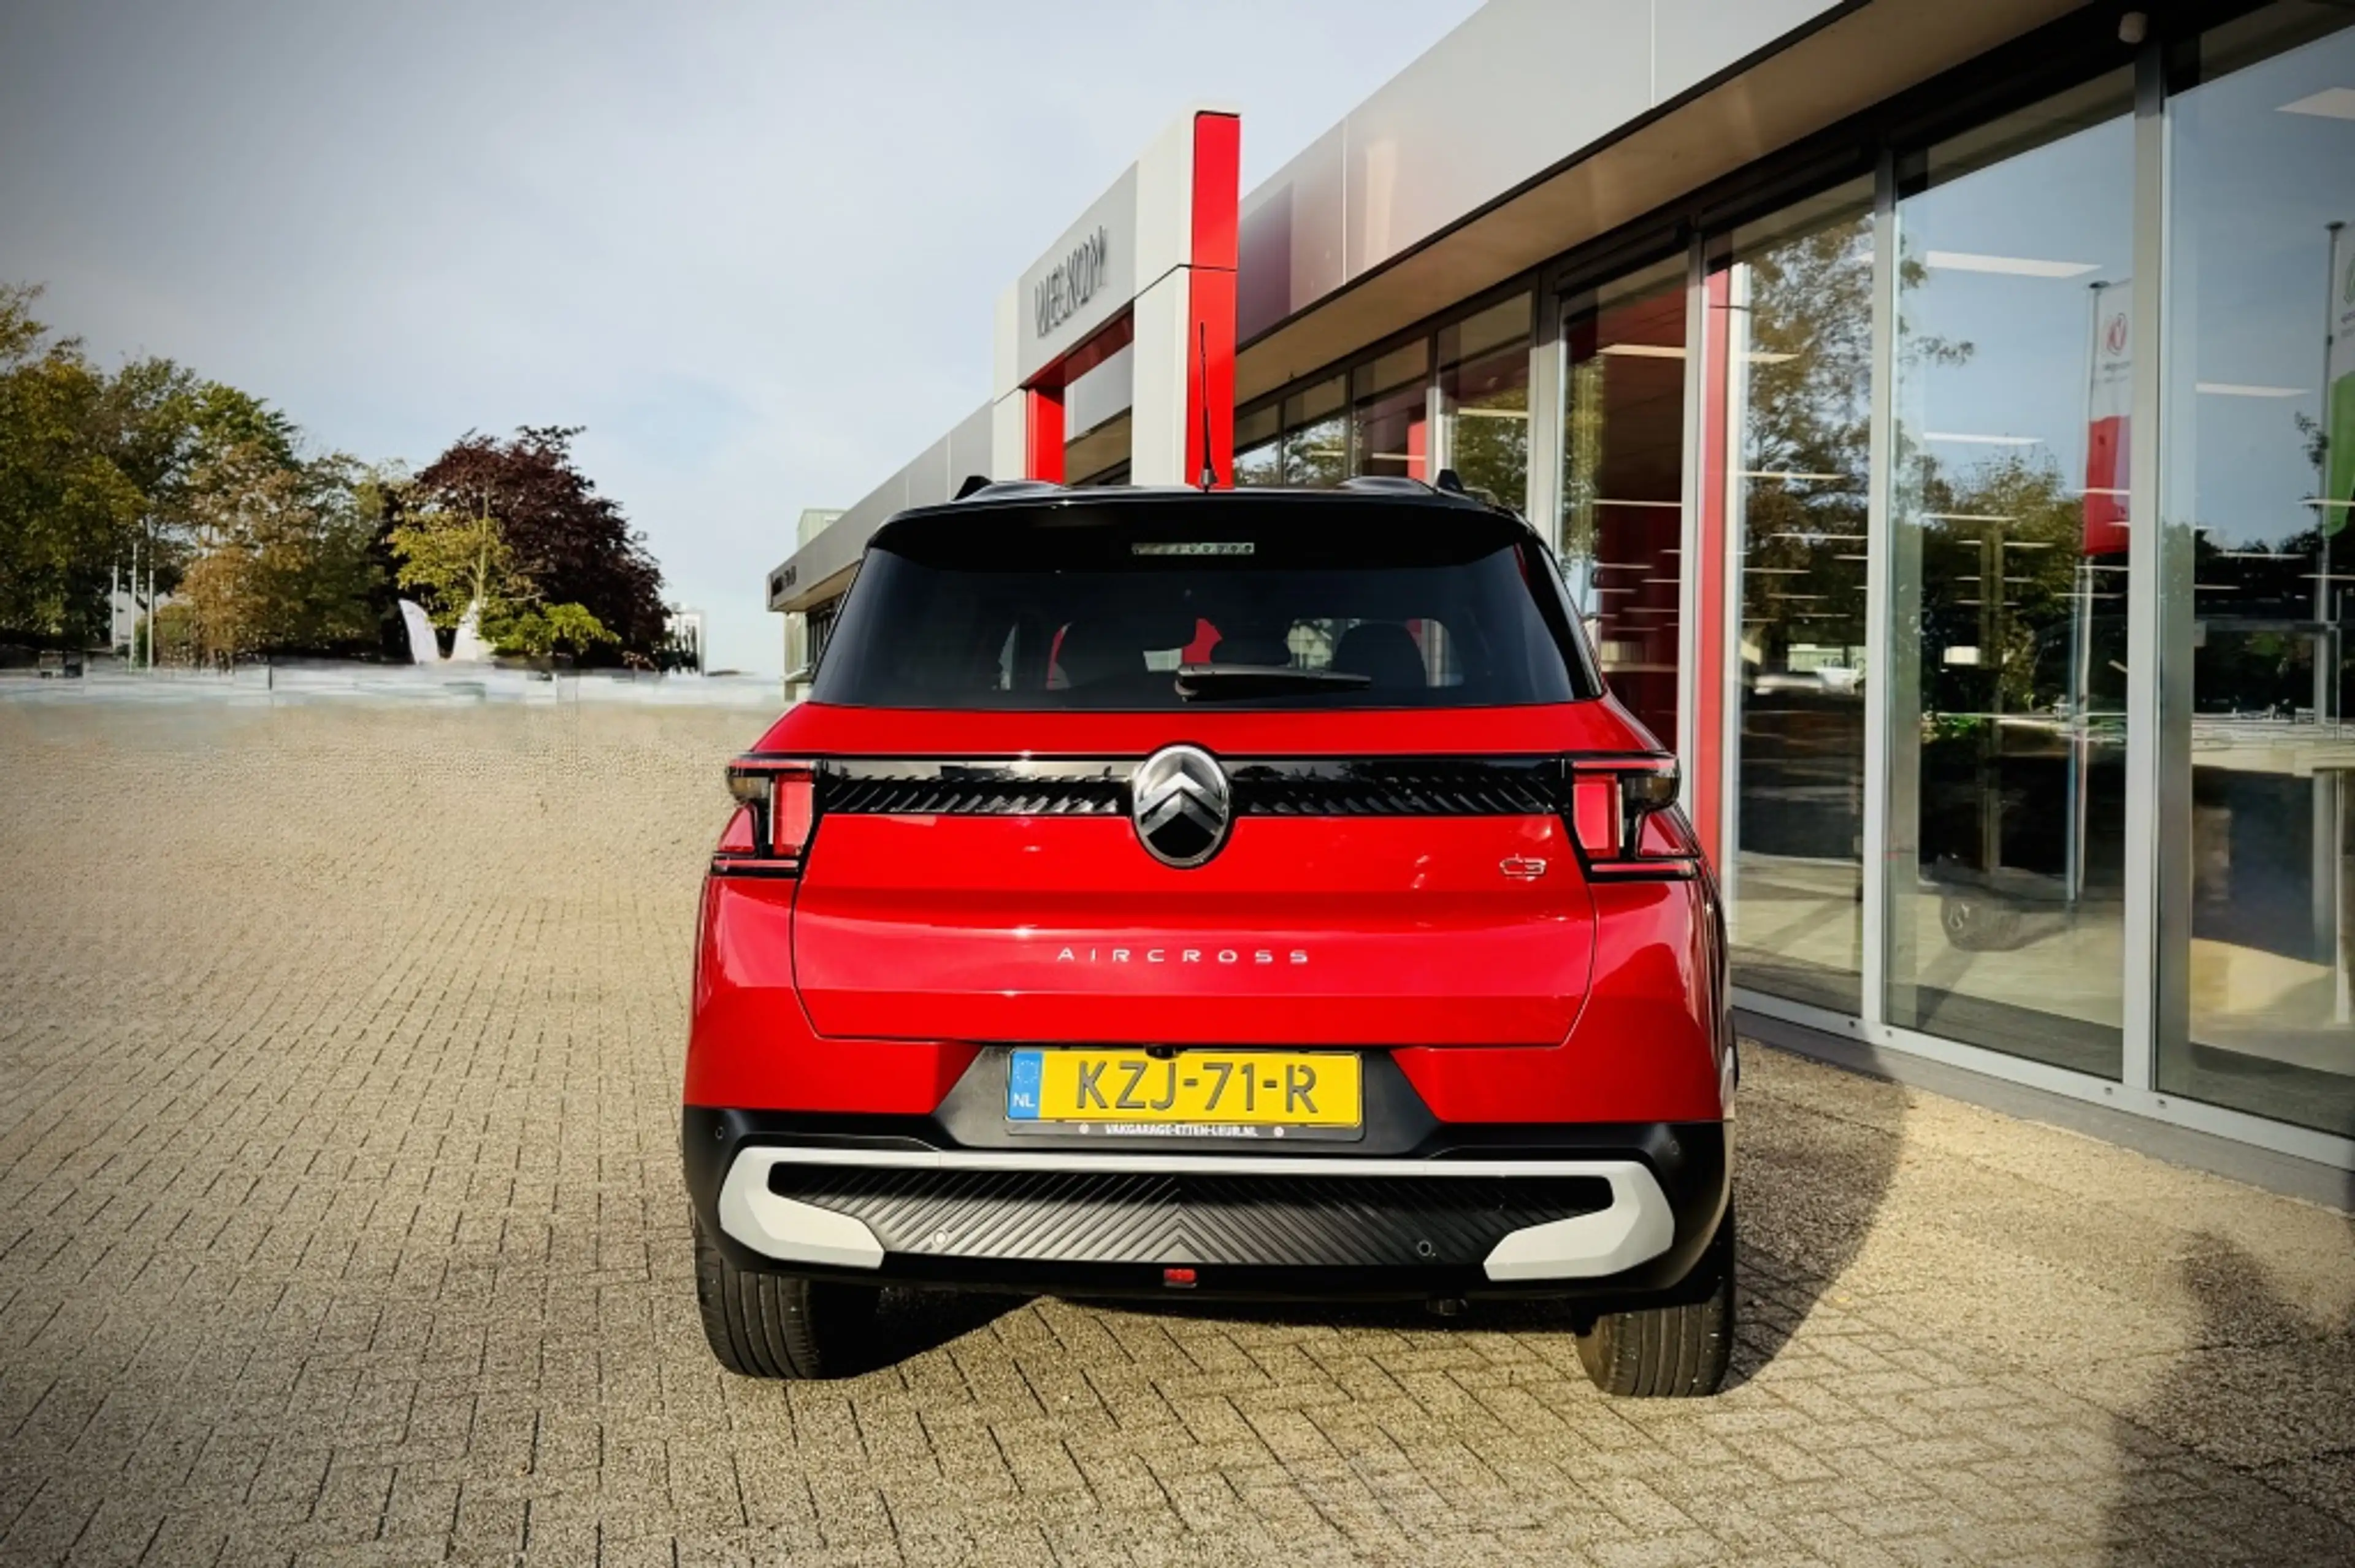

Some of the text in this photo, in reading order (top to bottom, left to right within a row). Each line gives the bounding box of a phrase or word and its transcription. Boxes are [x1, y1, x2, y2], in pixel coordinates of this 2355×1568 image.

[1499, 854, 1547, 876] C3
[1057, 947, 1309, 963] AIRCROSS
[1076, 1060, 1318, 1113] KZJ-71-R
[1013, 1092, 1035, 1107] NL
